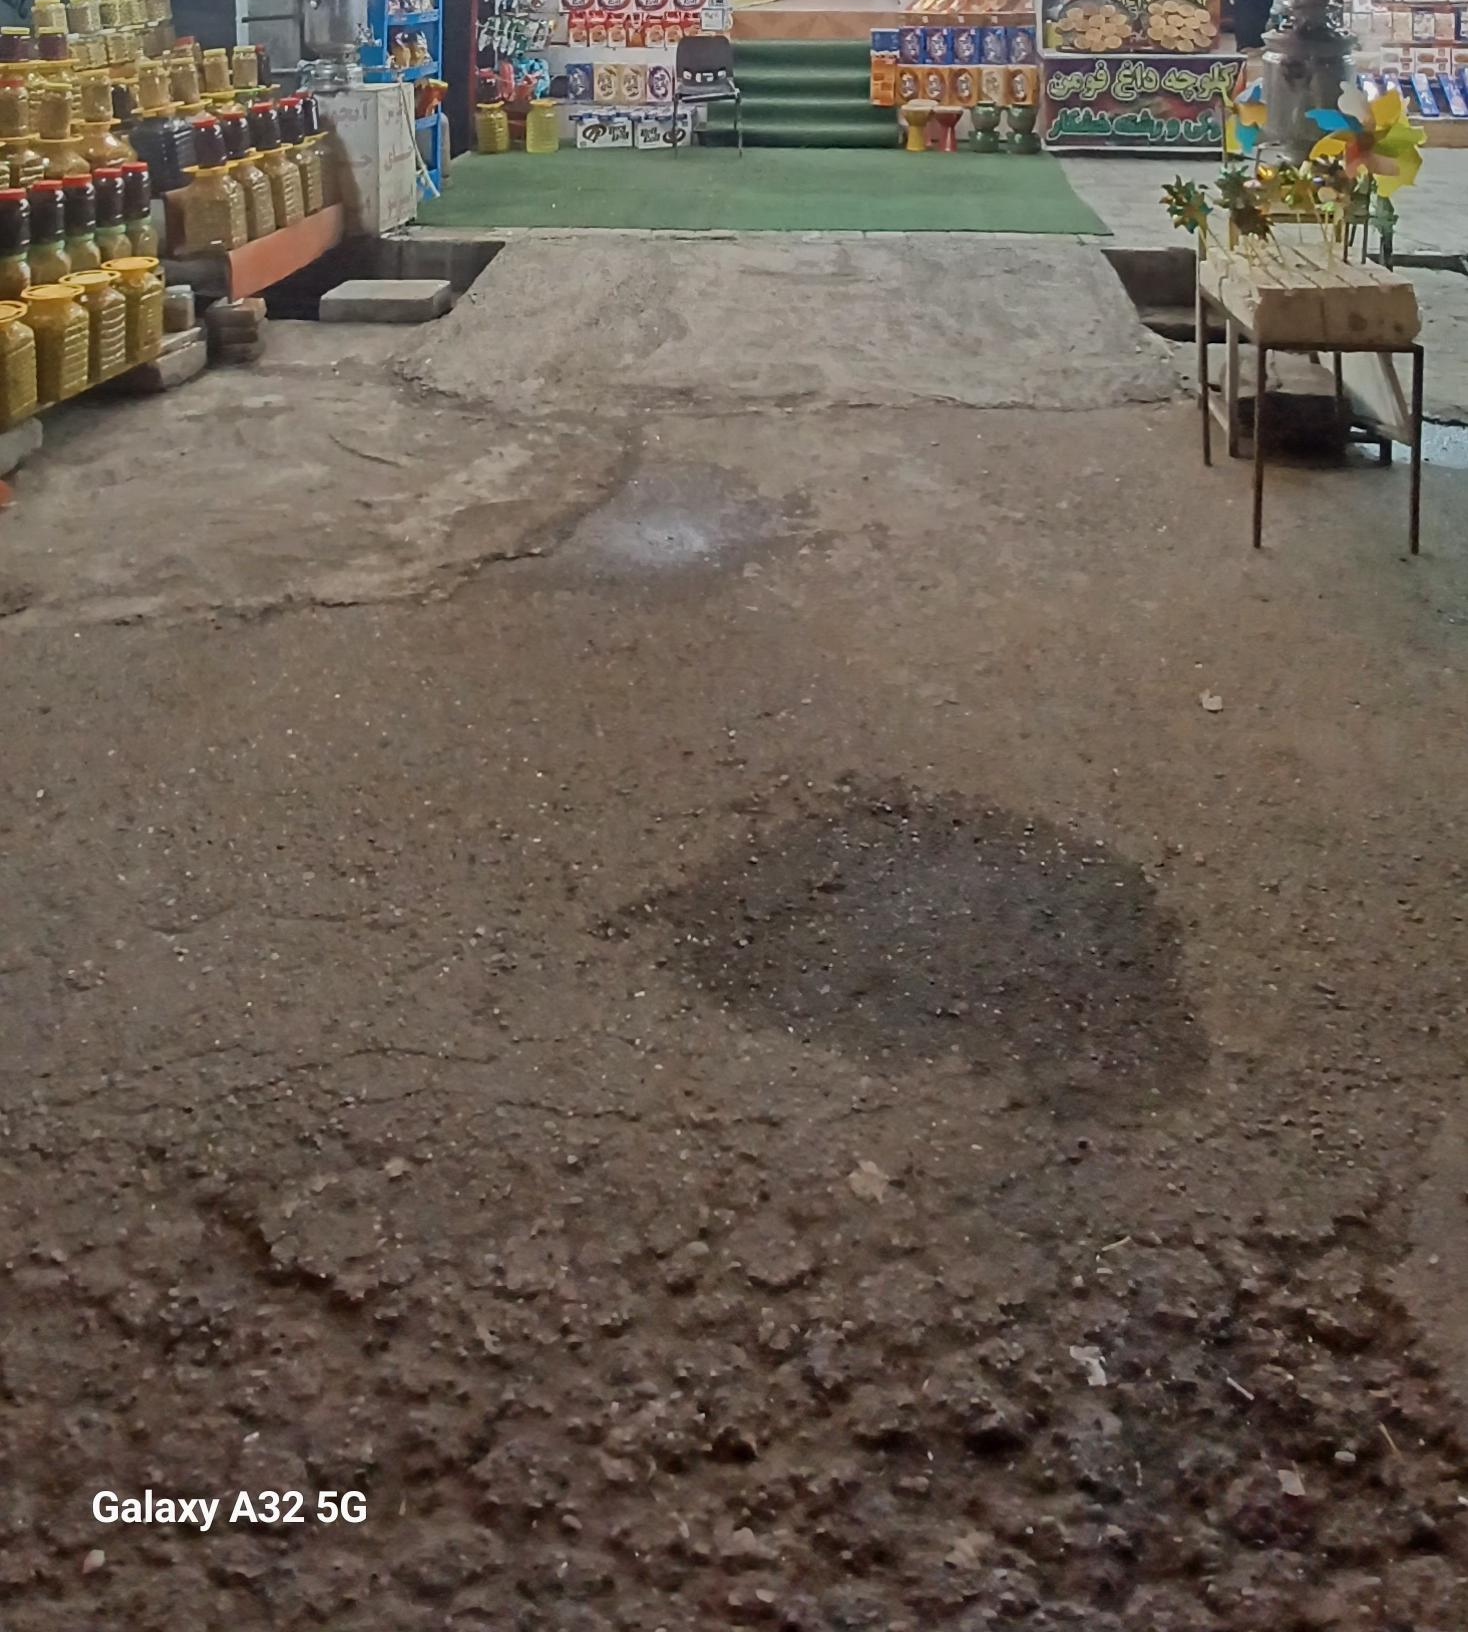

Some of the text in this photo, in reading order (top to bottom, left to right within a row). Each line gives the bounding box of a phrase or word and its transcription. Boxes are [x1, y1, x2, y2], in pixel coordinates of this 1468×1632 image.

[1047, 59, 1111, 101] فومن
[1111, 60, 1160, 101] داغ
[1162, 62, 1239, 102] کلوچه
